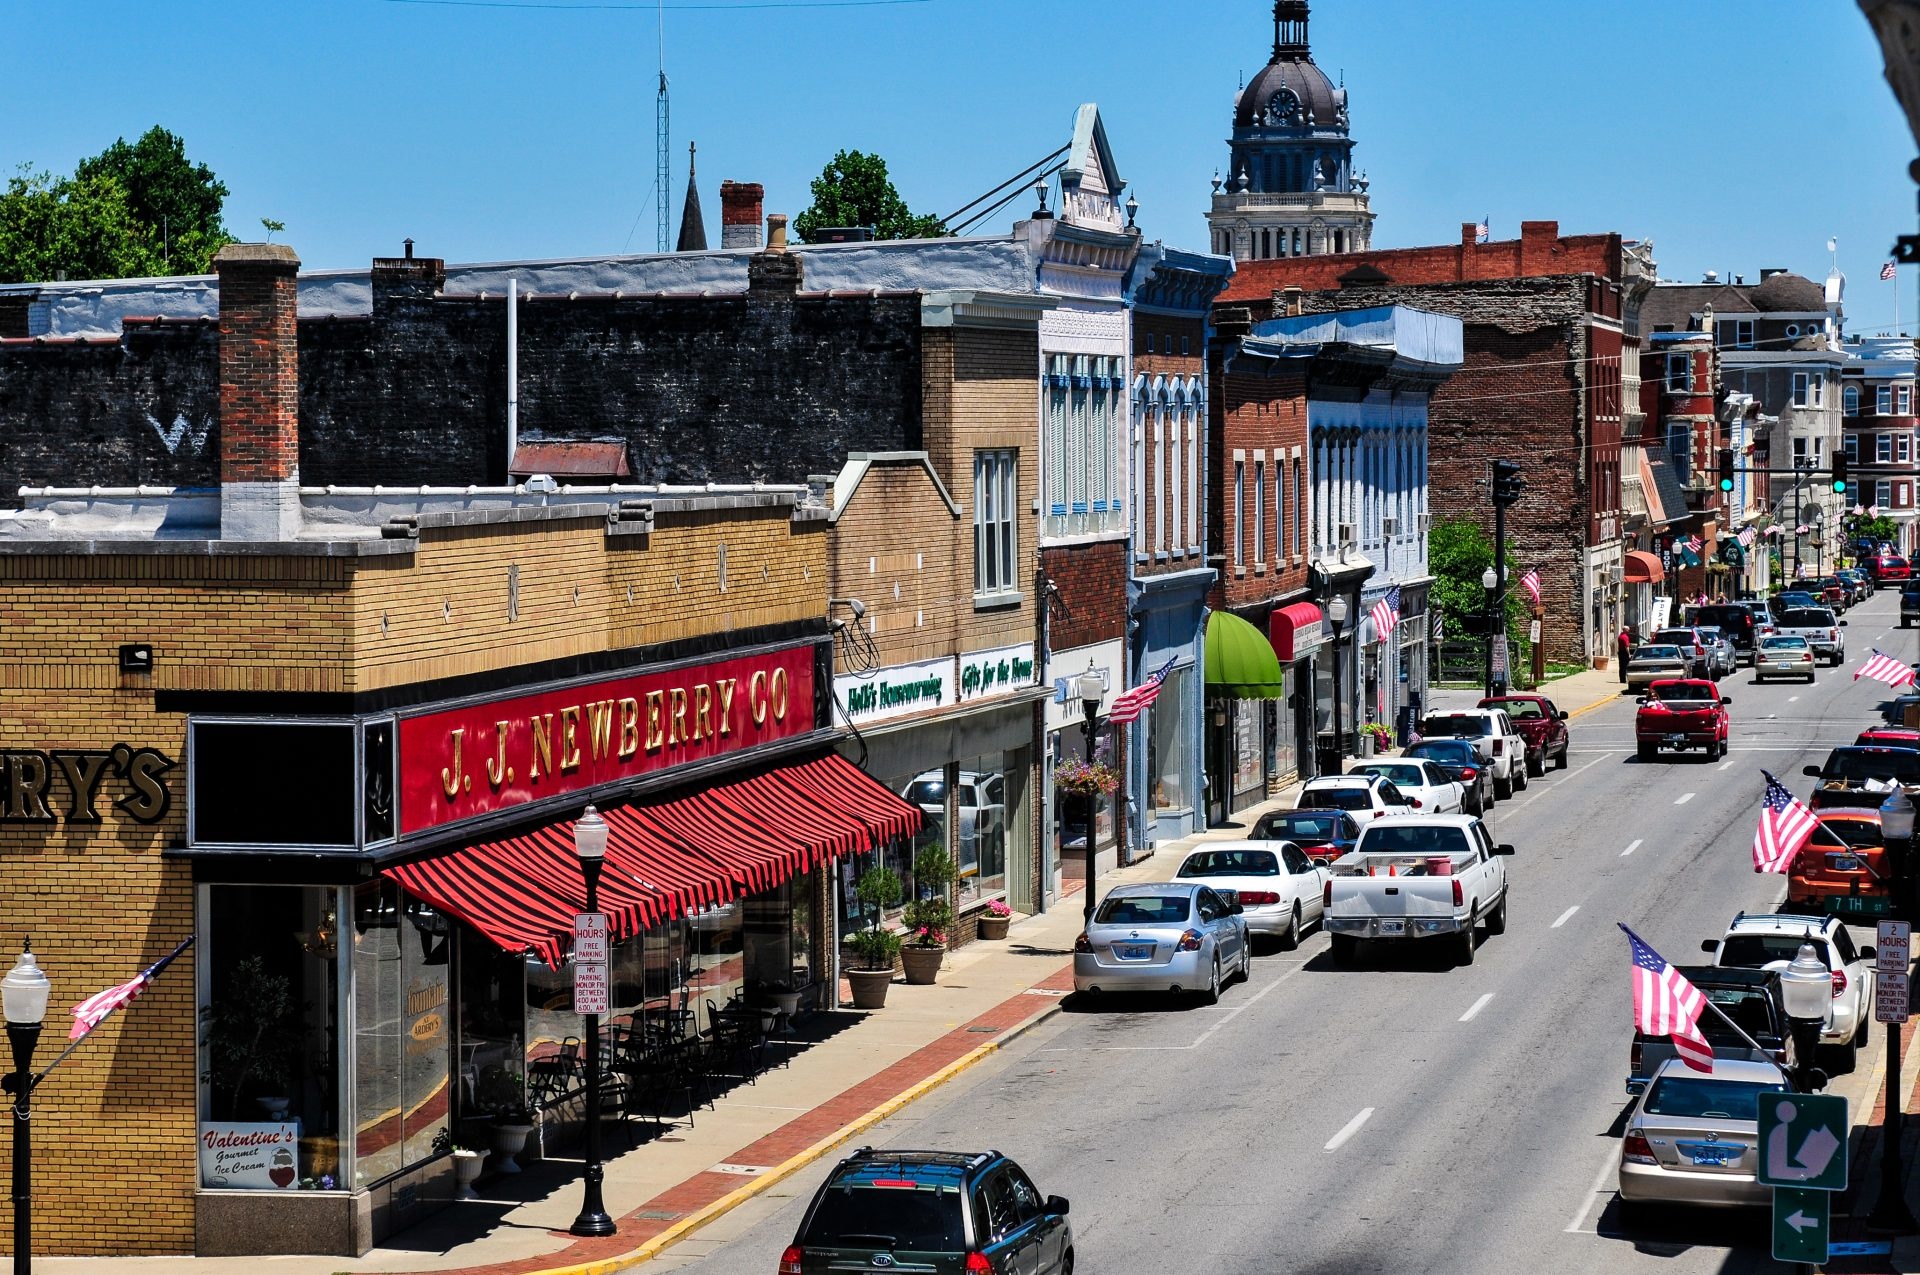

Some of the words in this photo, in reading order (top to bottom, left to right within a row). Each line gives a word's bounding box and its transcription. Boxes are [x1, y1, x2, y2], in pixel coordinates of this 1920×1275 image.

[961, 663, 980, 695] Gifts
[981, 661, 995, 694] for
[998, 659, 1009, 681] the
[1012, 657, 1033, 679] Home
[442, 728, 472, 796] J.
[486, 720, 515, 785] J.
[529, 678, 737, 779] NEWBERRY
[751, 667, 789, 724] CO
[0, 748, 172, 822] RY'S
[1835, 897, 1842, 910] 7
[1848, 897, 1863, 911] TH
[1874, 903, 1882, 911] ST
[587, 917, 594, 928] 2
[576, 928, 605, 939] HOURS
[1890, 926, 1897, 936] 2
[583, 942, 599, 950] FREE
[1879, 937, 1908, 948] HOURS
[1885, 951, 1901, 959] FREE
[1880, 959, 1905, 967] PARKING
[1879, 981, 1905, 990] PARKING
[578, 989, 604, 997] BETWEEN
[414, 1017, 439, 1036] ARDERY'S
[203, 1124, 294, 1150] Valentine's
[215, 1147, 260, 1163] Gourmet
[214, 1164, 230, 1175] Ice
[231, 1161, 265, 1174] Cream
